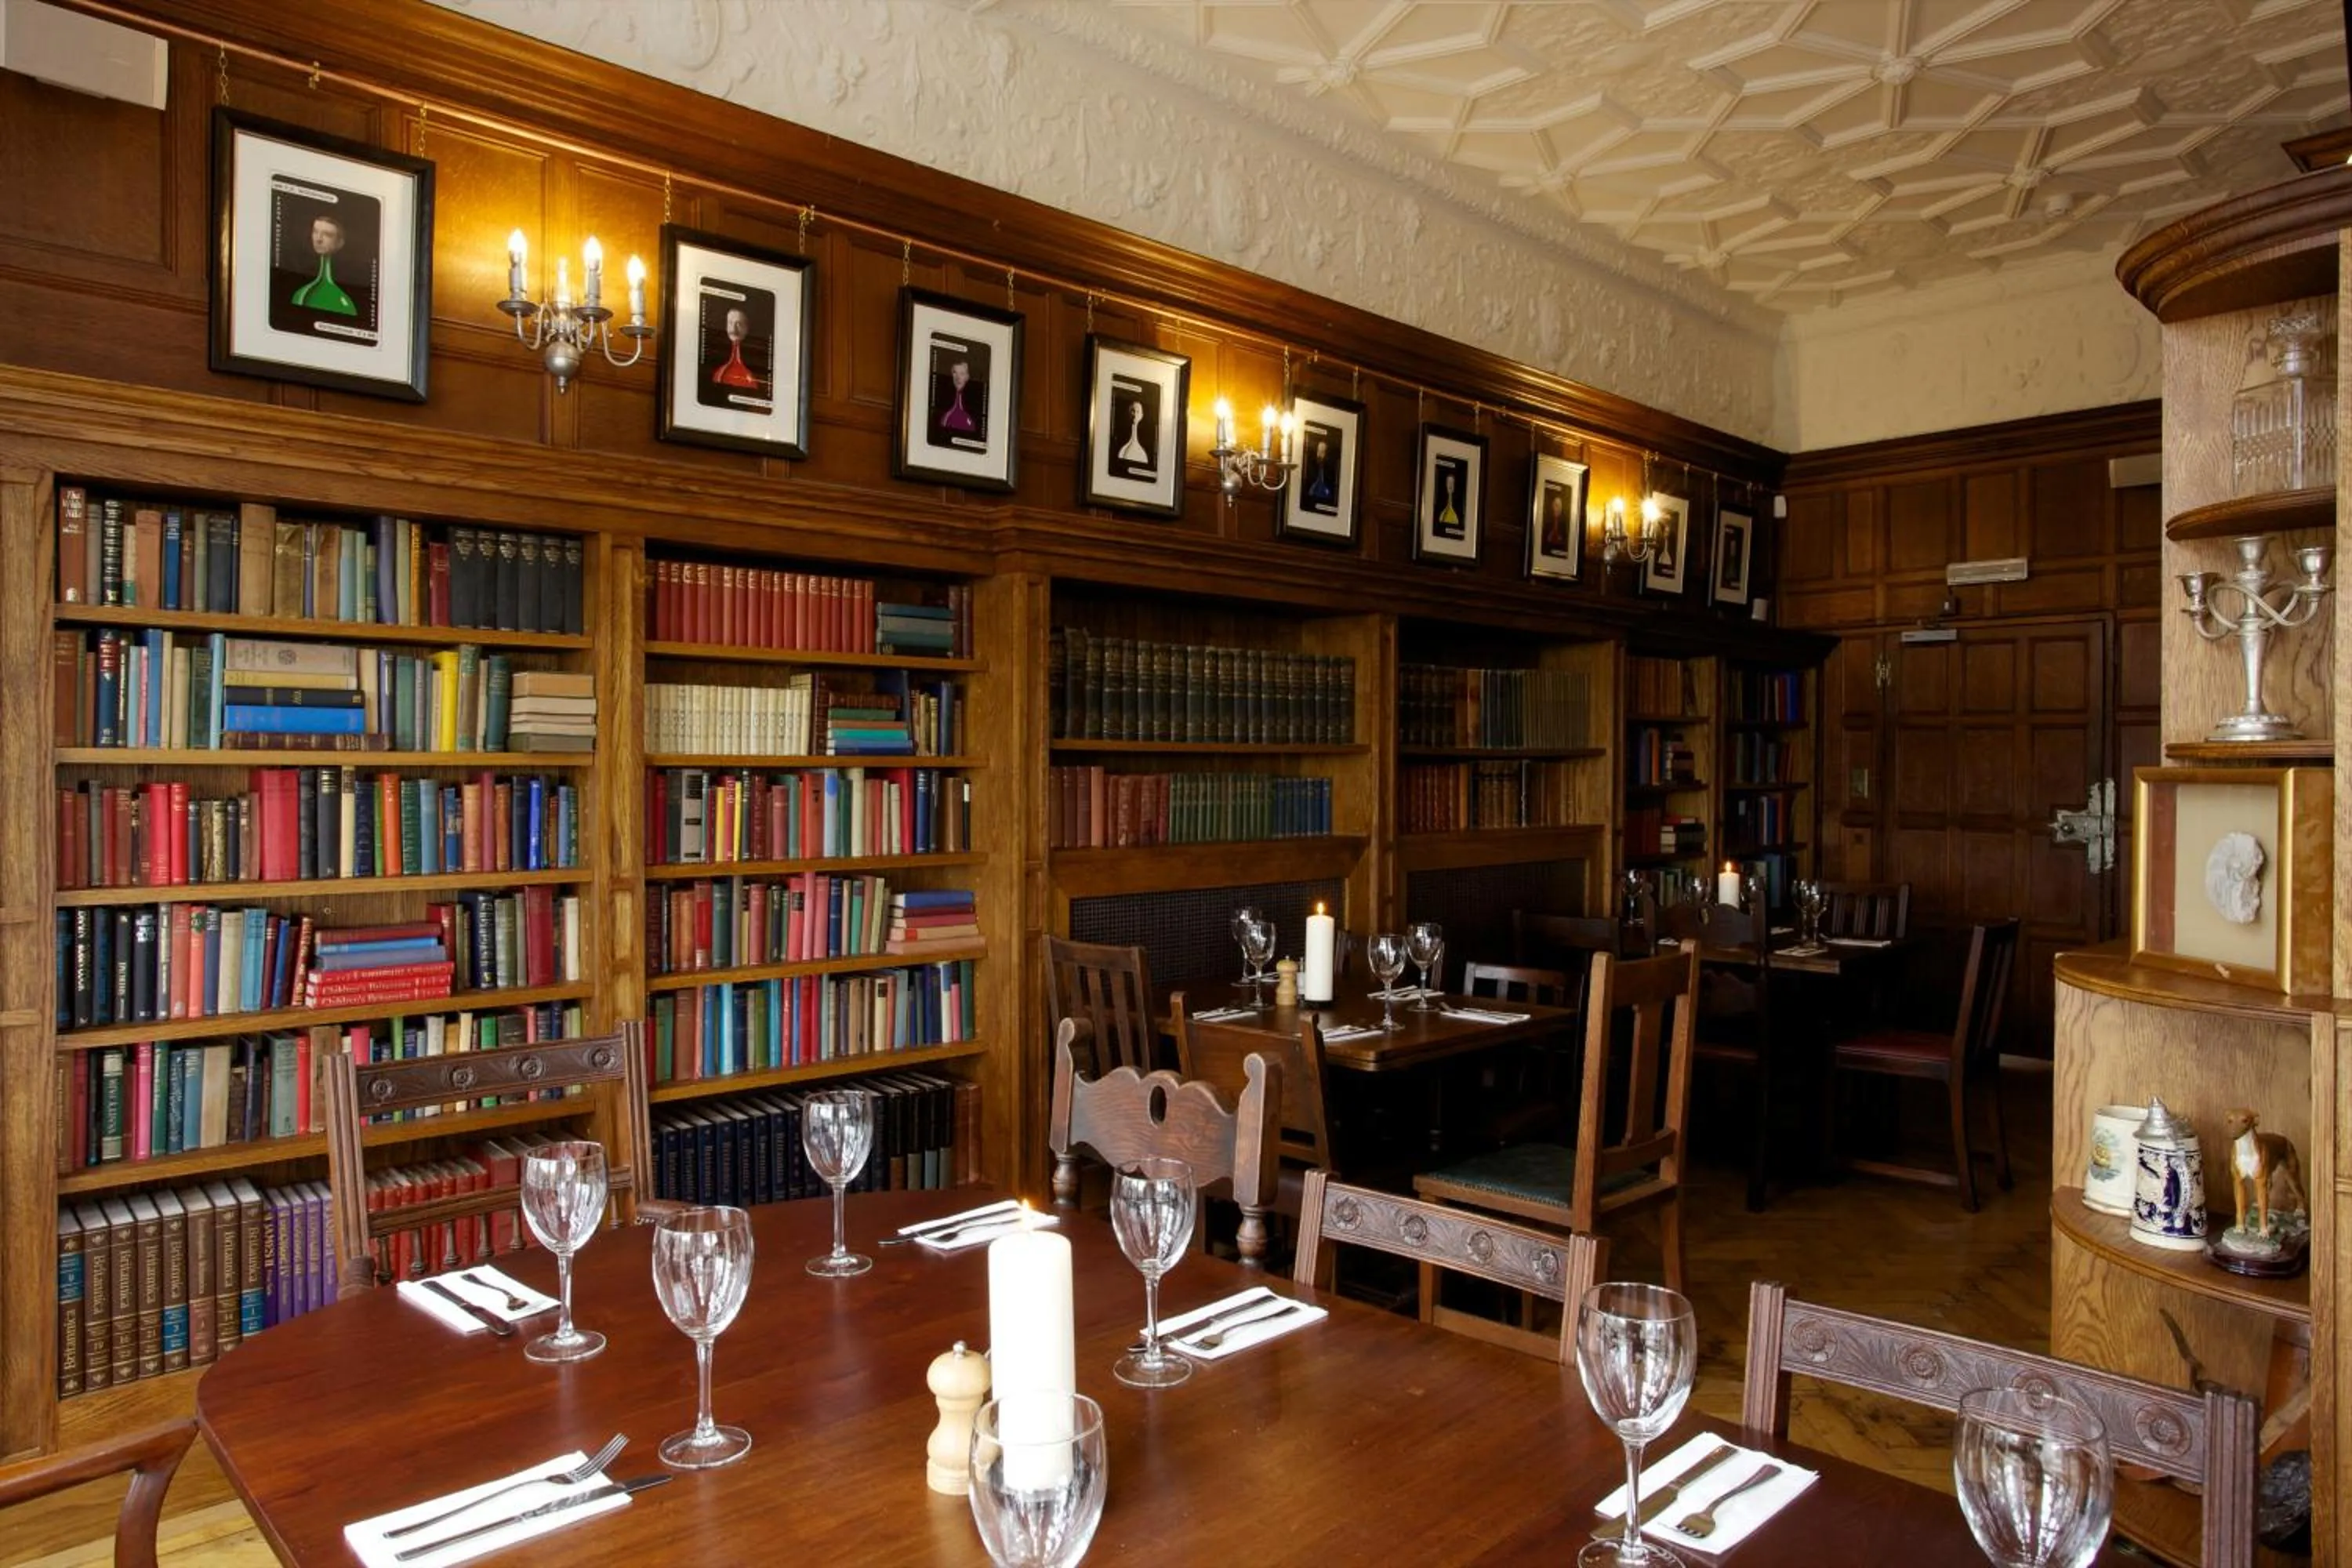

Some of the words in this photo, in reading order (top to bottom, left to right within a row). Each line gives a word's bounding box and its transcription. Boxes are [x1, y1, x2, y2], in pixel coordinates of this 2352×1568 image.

[120, 1248, 132, 1309] Britannica
[147, 1244, 159, 1304] Britannica
[171, 1240, 184, 1298] Britannica
[224, 1231, 237, 1288] Britannica
[249, 1226, 260, 1283] Britannica
[93, 1254, 107, 1316] Britannica
[64, 1308, 77, 1370] Britannica
